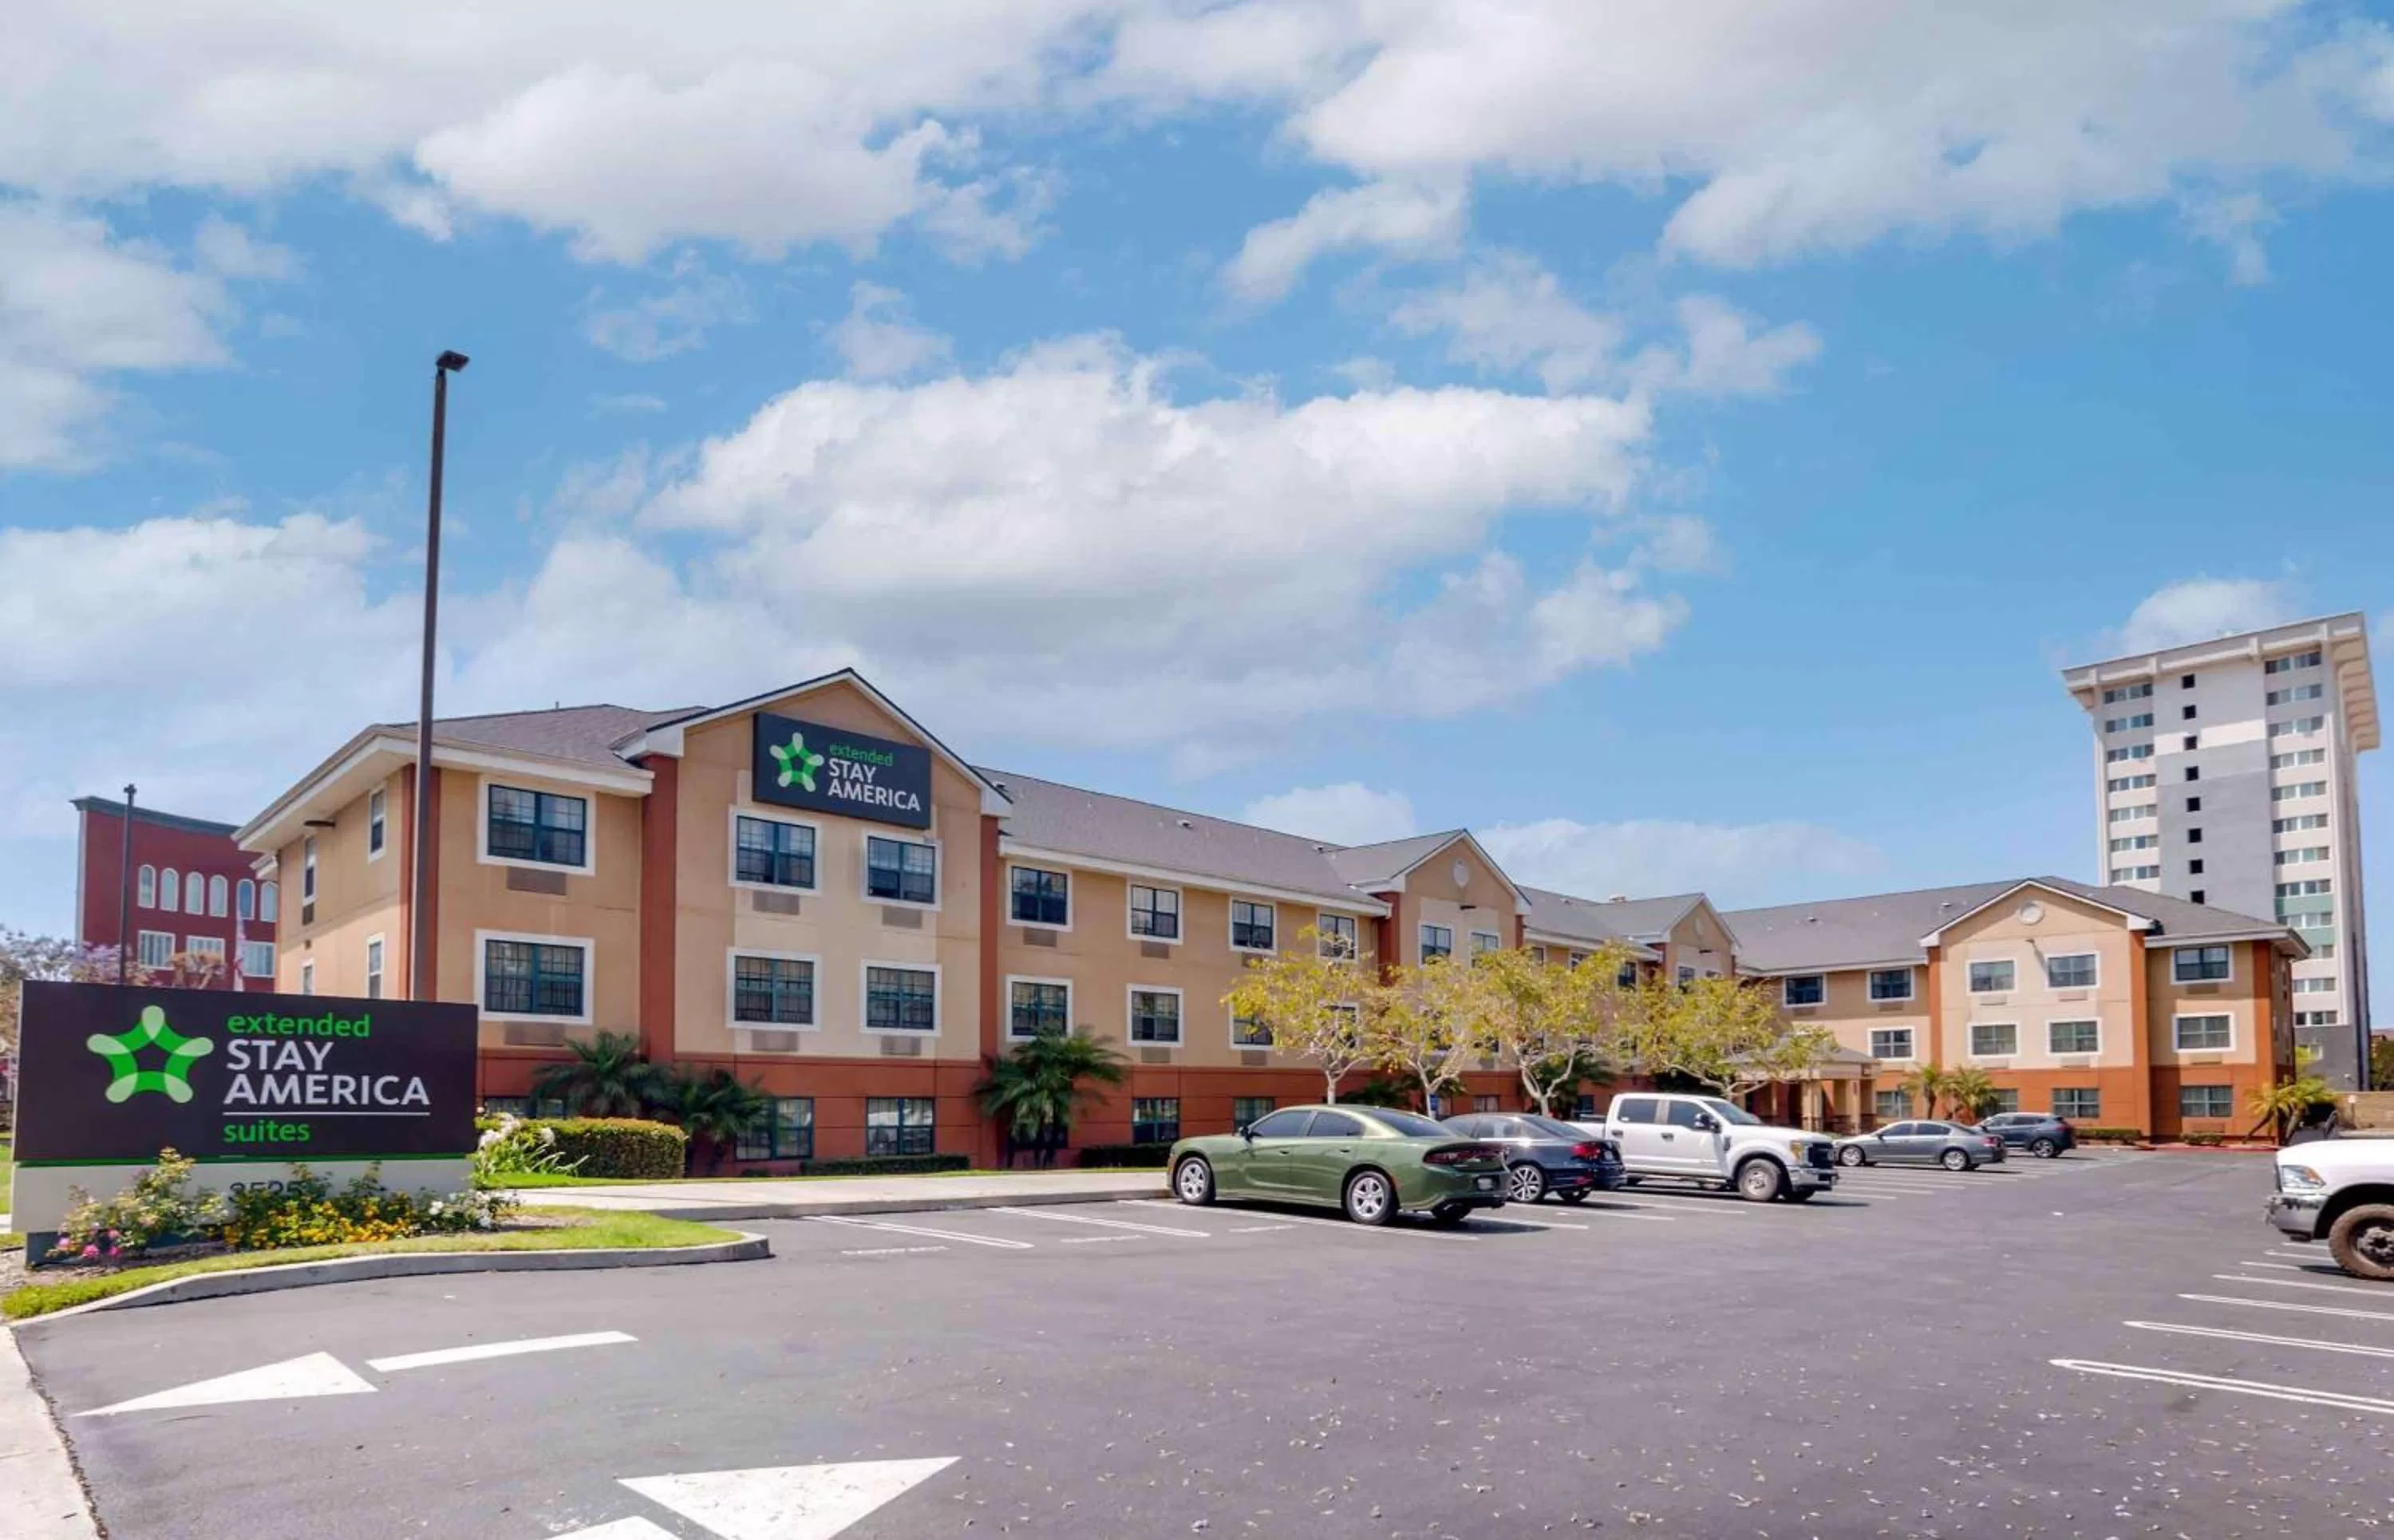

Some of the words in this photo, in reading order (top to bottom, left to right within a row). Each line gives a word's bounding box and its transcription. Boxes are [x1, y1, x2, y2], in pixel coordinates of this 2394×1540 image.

[829, 744, 894, 766] extended
[828, 758, 877, 783] STAY
[828, 779, 921, 811] AMERICA
[227, 1012, 370, 1037] extended
[227, 1038, 334, 1071] STAY
[223, 1074, 430, 1105] AMERICA
[223, 1119, 310, 1143] suites
